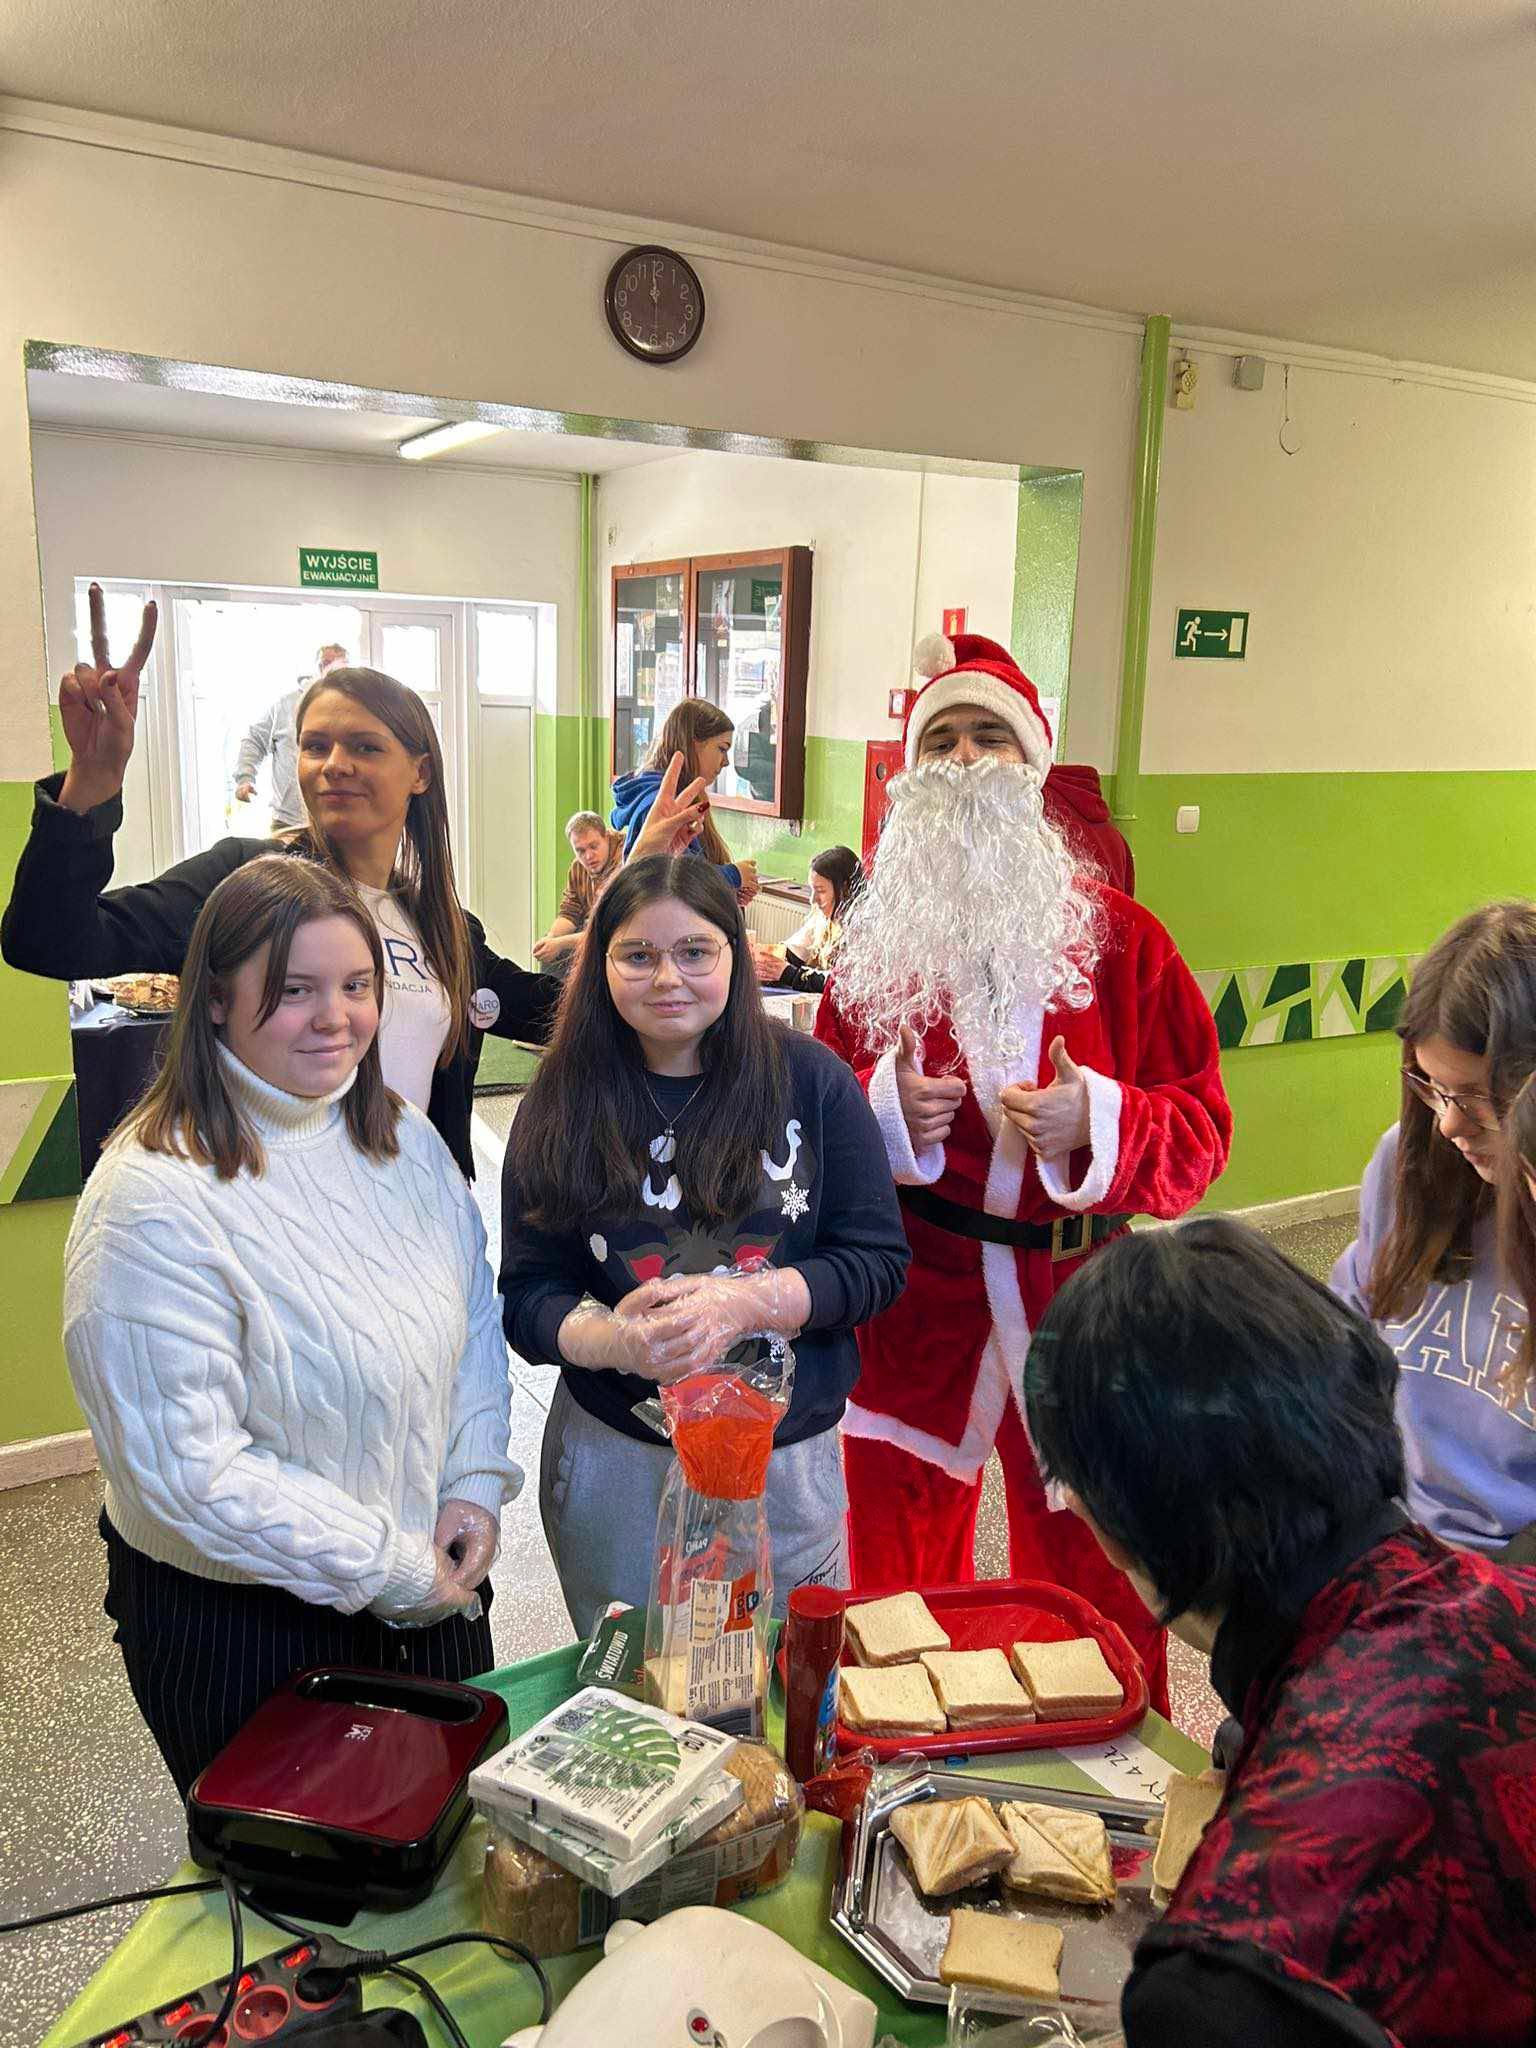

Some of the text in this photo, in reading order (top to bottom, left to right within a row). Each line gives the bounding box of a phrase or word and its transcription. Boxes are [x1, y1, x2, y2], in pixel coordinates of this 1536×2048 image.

[638, 263, 647, 280] 11
[652, 260, 665, 278] 12
[625, 274, 638, 292] 10
[617, 290, 628, 308] 9
[680, 284, 690, 300] 2
[623, 311, 632, 328] 8
[684, 304, 694, 321] 3
[635, 325, 643, 339] 7
[678, 323, 687, 337] 4
[650, 333, 659, 347] 6
[665, 332, 675, 348] 5
[305, 554, 372, 571] WYJŚCIE
[303, 571, 376, 583] EWAKUACYJNE
[595, 1629, 629, 1681] ŚWIATOWID
[1142, 1780, 1166, 1801] TY
